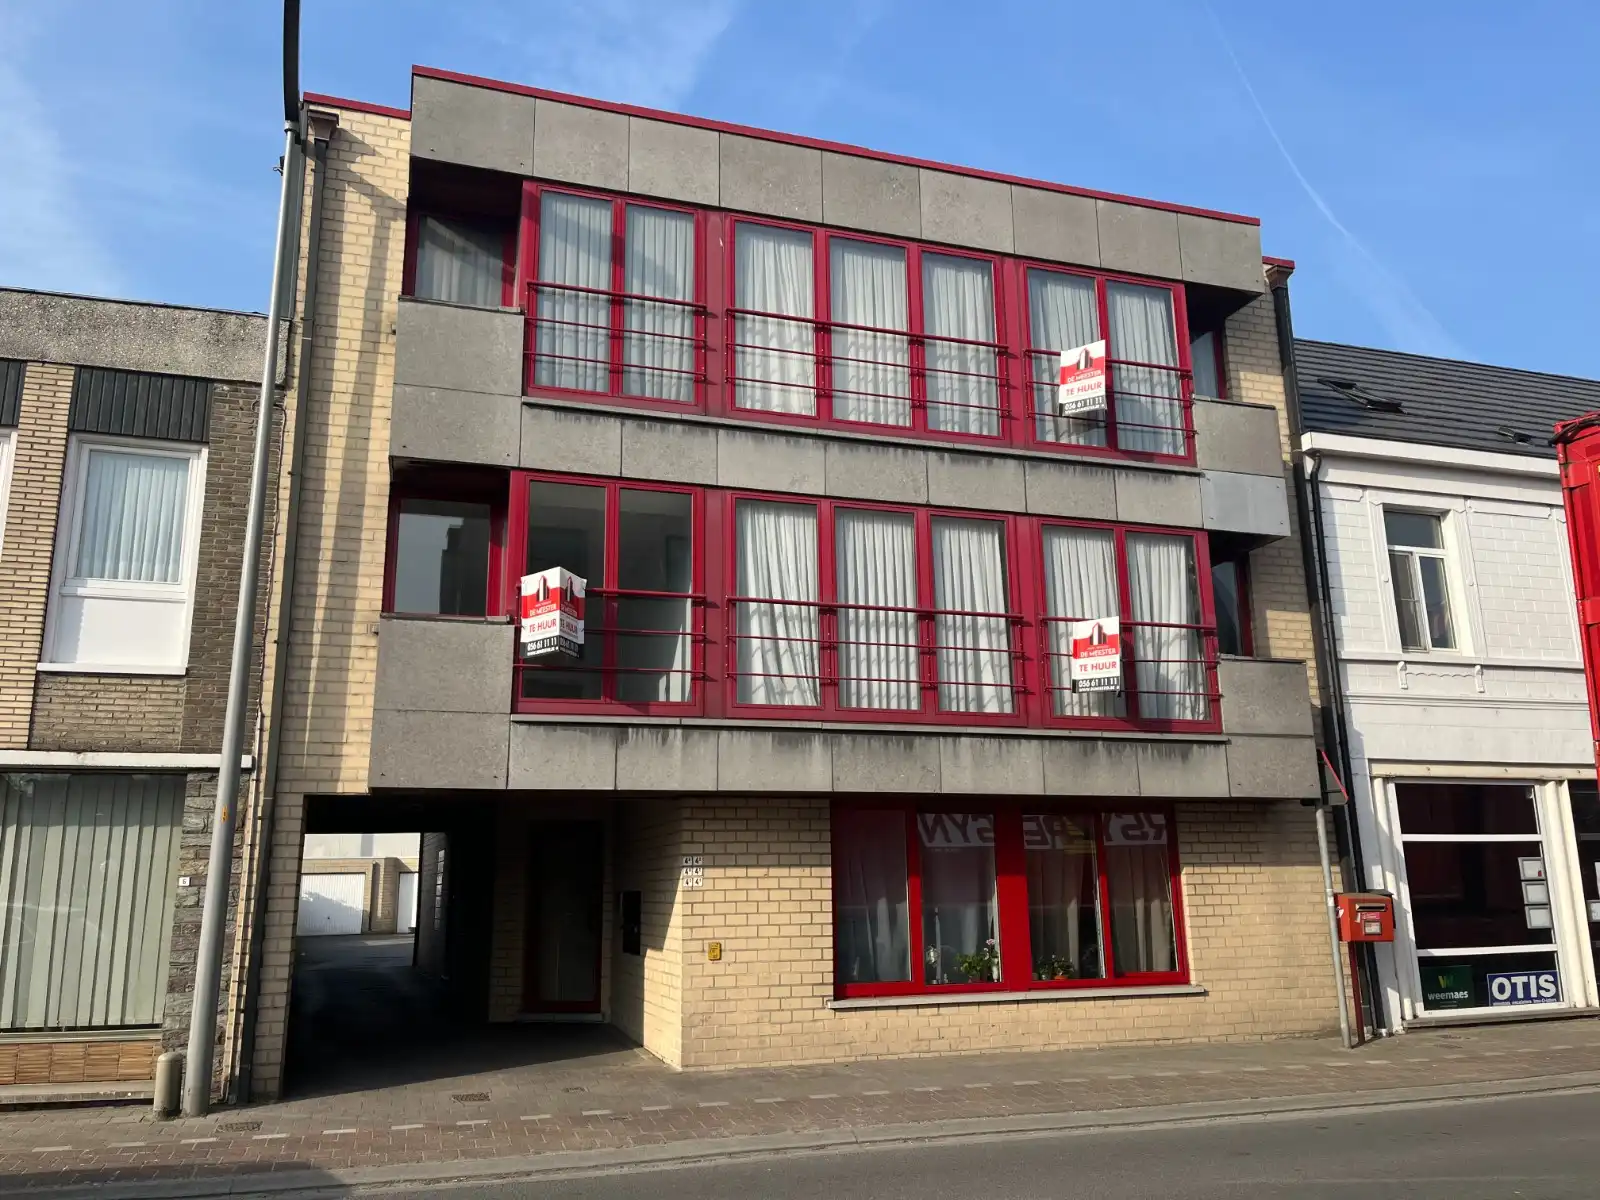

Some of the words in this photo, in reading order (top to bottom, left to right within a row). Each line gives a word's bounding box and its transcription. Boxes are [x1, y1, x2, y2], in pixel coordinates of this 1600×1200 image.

[1066, 388, 1075, 396] TE
[1077, 382, 1102, 393] HUUR
[529, 624, 536, 633] TE
[537, 618, 557, 631] HUUR
[1079, 664, 1088, 672] TE
[1091, 661, 1117, 671] HUUR
[1492, 974, 1557, 1001] OTIS
[1428, 991, 1468, 1000] weemaes
